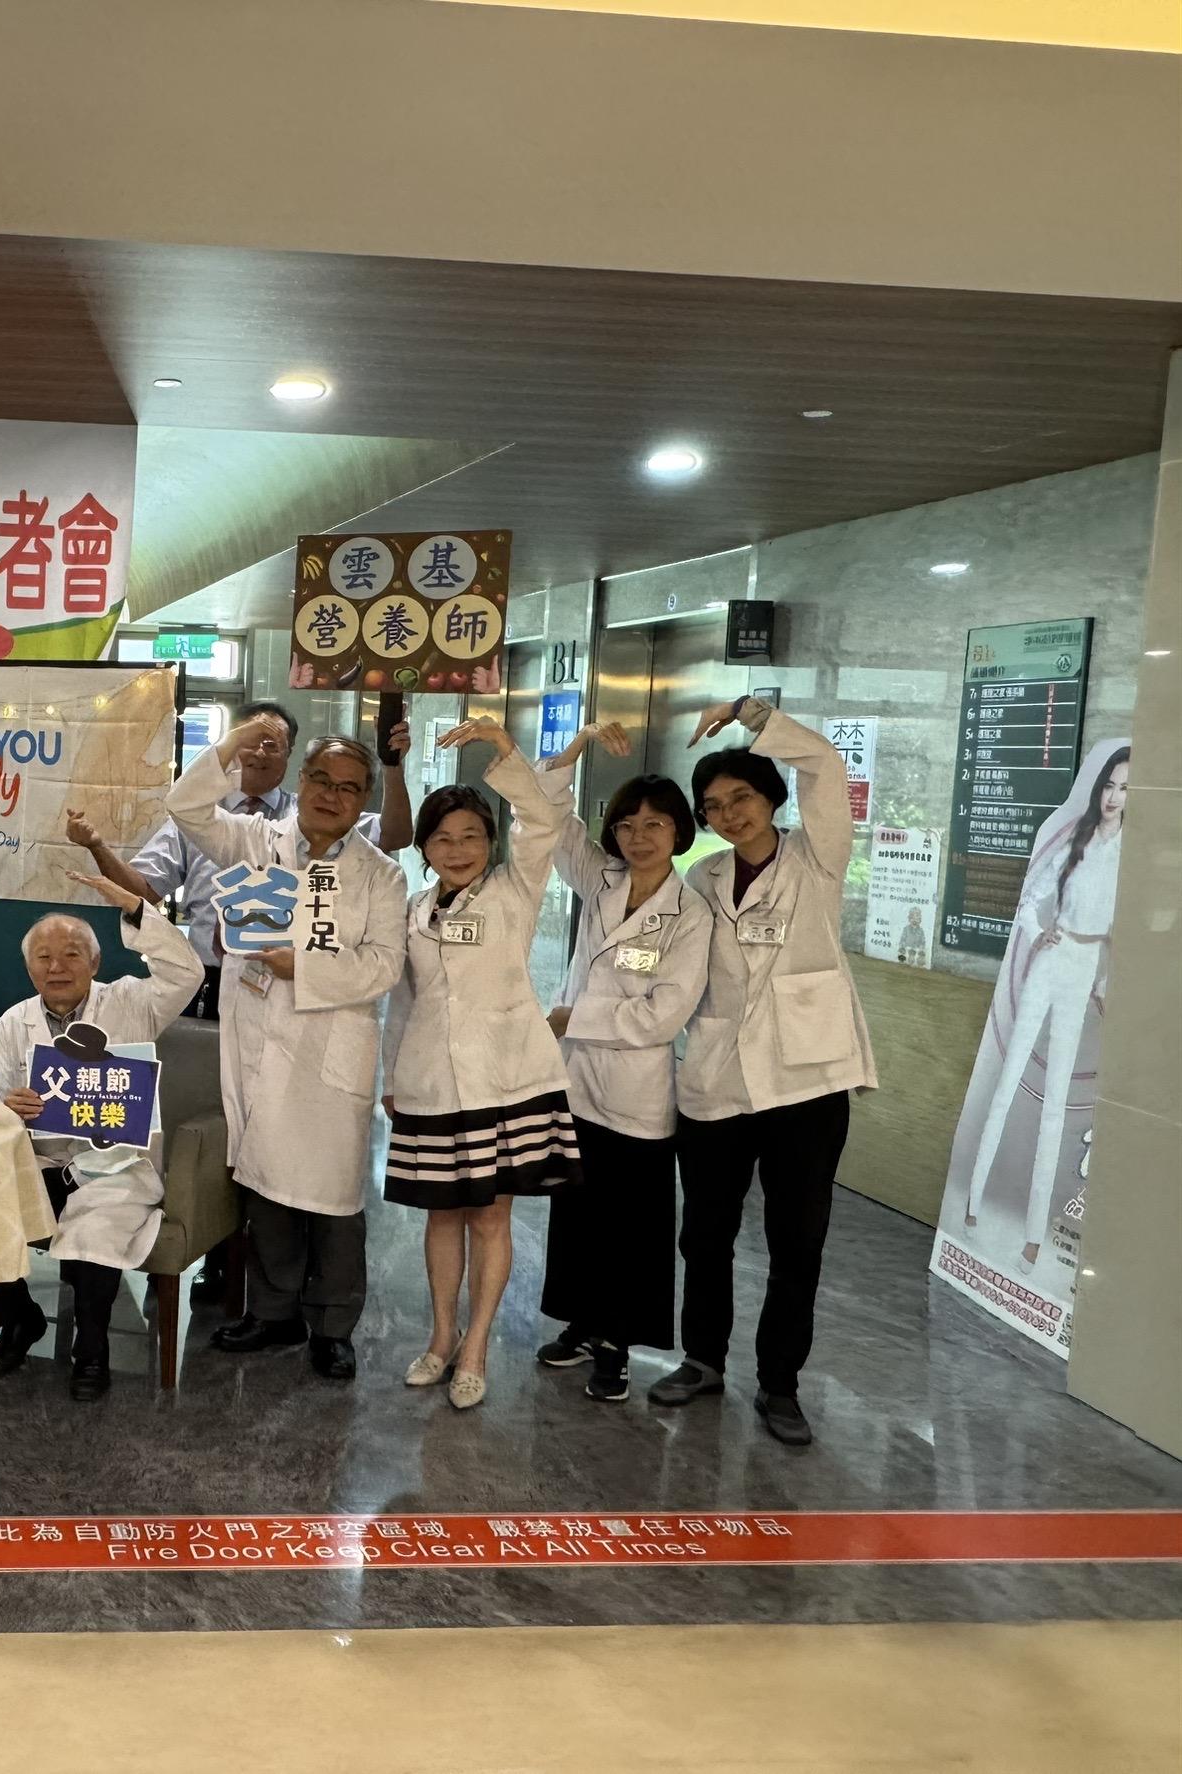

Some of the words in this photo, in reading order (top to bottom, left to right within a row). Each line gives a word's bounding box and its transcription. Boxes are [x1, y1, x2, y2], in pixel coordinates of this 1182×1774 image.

[341, 541, 466, 590] 雲基
[306, 603, 488, 653] 營養師
[552, 640, 579, 684] B1
[40, 1066, 131, 1102] 父親節
[70, 1101, 126, 1128] 快樂
[107, 1544, 178, 1561] Fire
[188, 1543, 276, 1560] Door
[286, 1543, 381, 1563] Keep
[391, 1541, 485, 1558] Clear
[500, 1541, 538, 1557] At
[547, 1540, 589, 1557] All
[593, 1539, 707, 1557] Times
